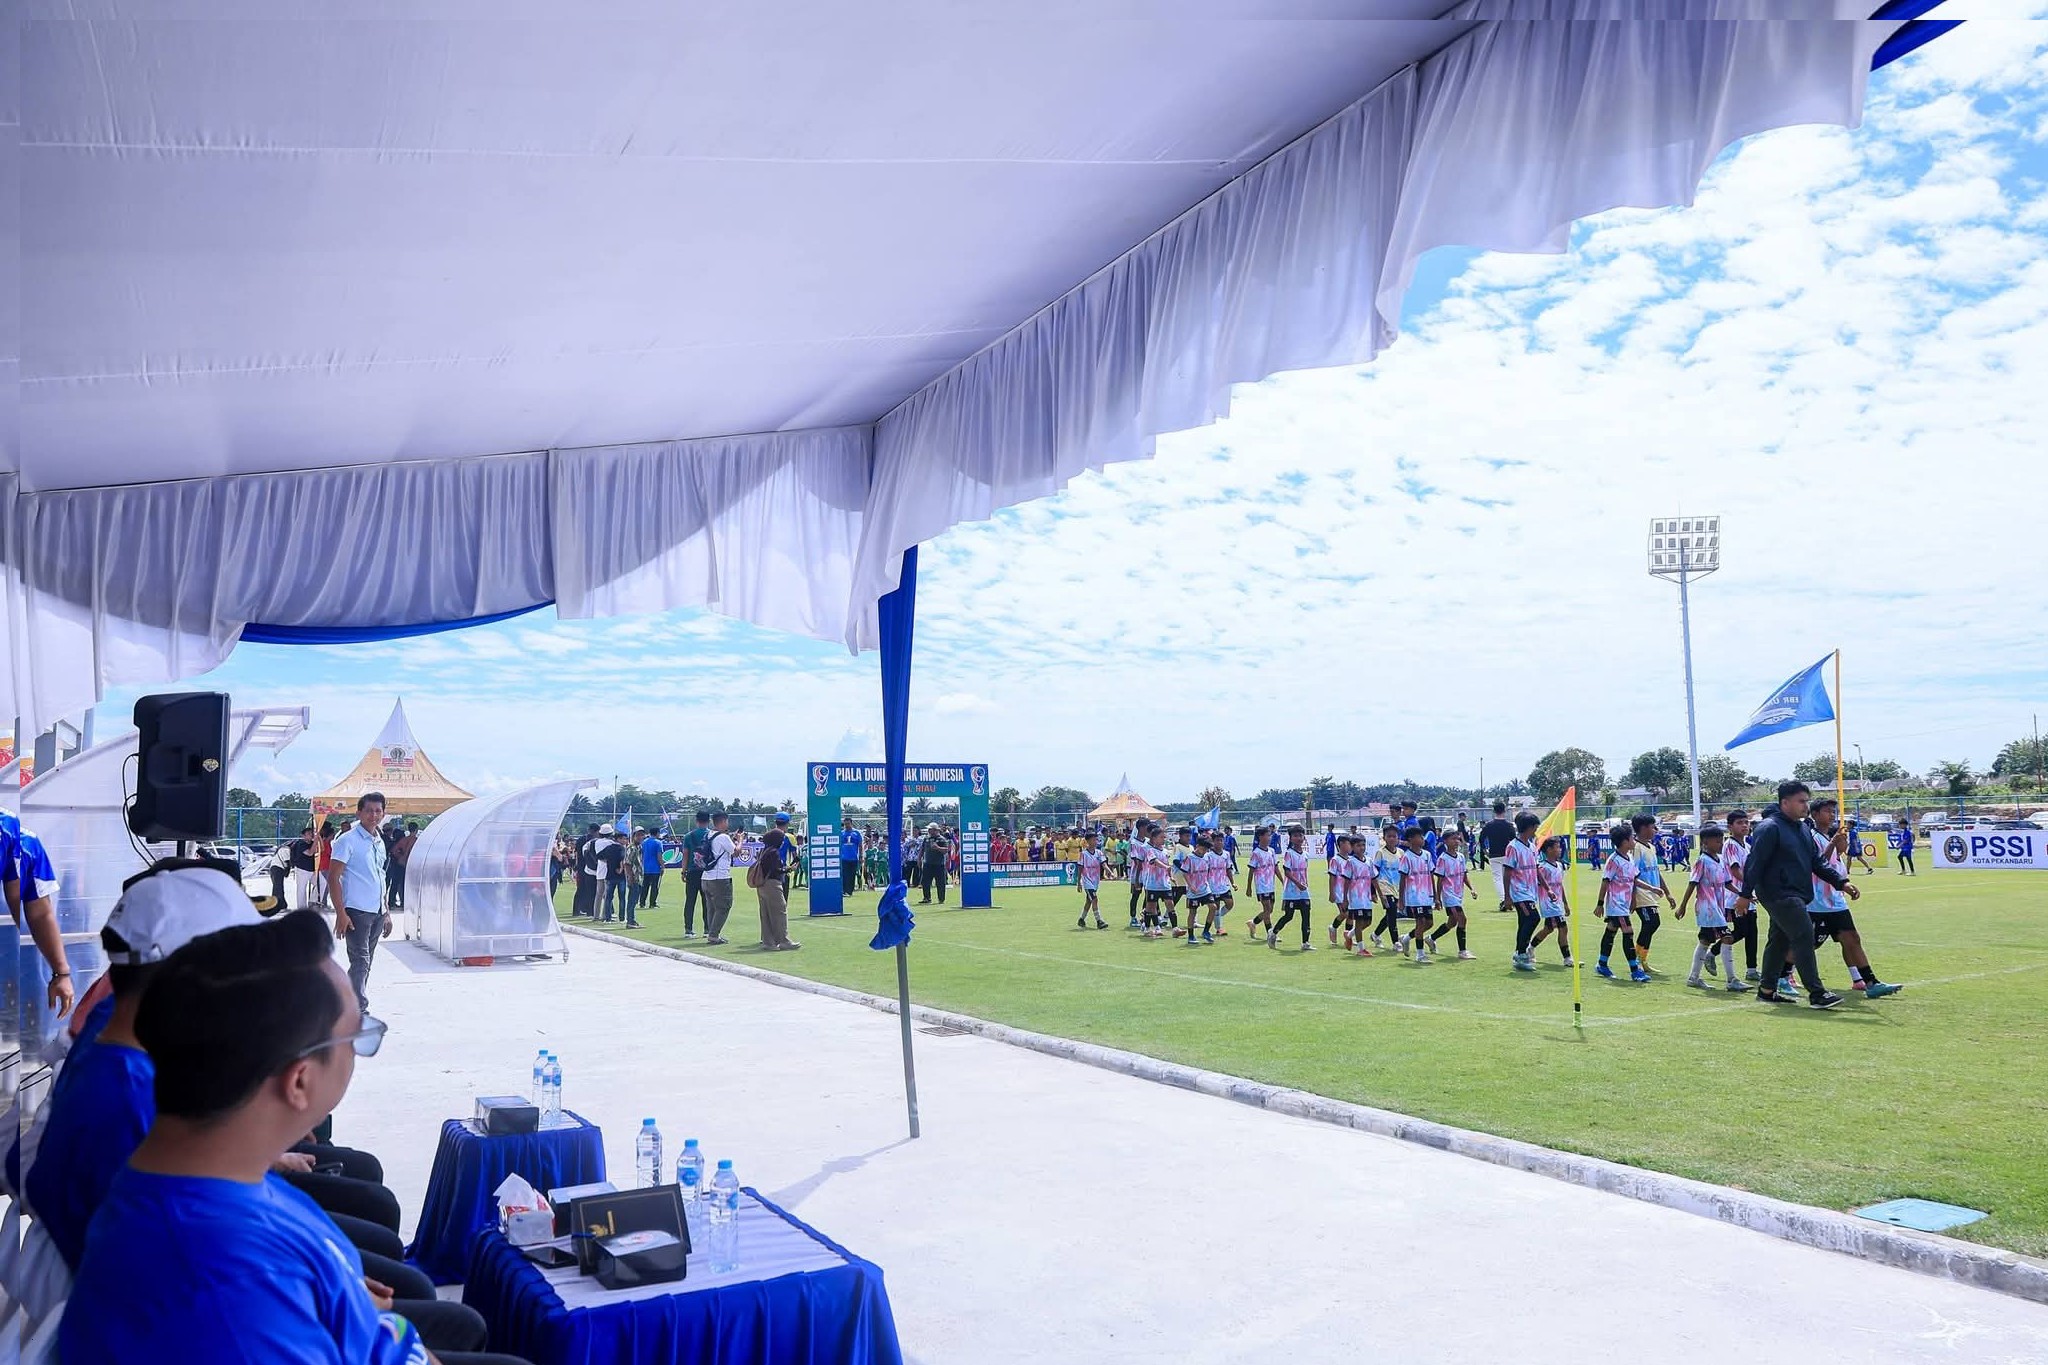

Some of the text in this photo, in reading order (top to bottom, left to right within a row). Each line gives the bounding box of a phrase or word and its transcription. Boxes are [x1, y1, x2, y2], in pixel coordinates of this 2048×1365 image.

[836, 767, 964, 782] PIALA DUNI AK INDONESIA
[915, 785, 936, 793] RIAU
[1971, 836, 2033, 857] PSSI
